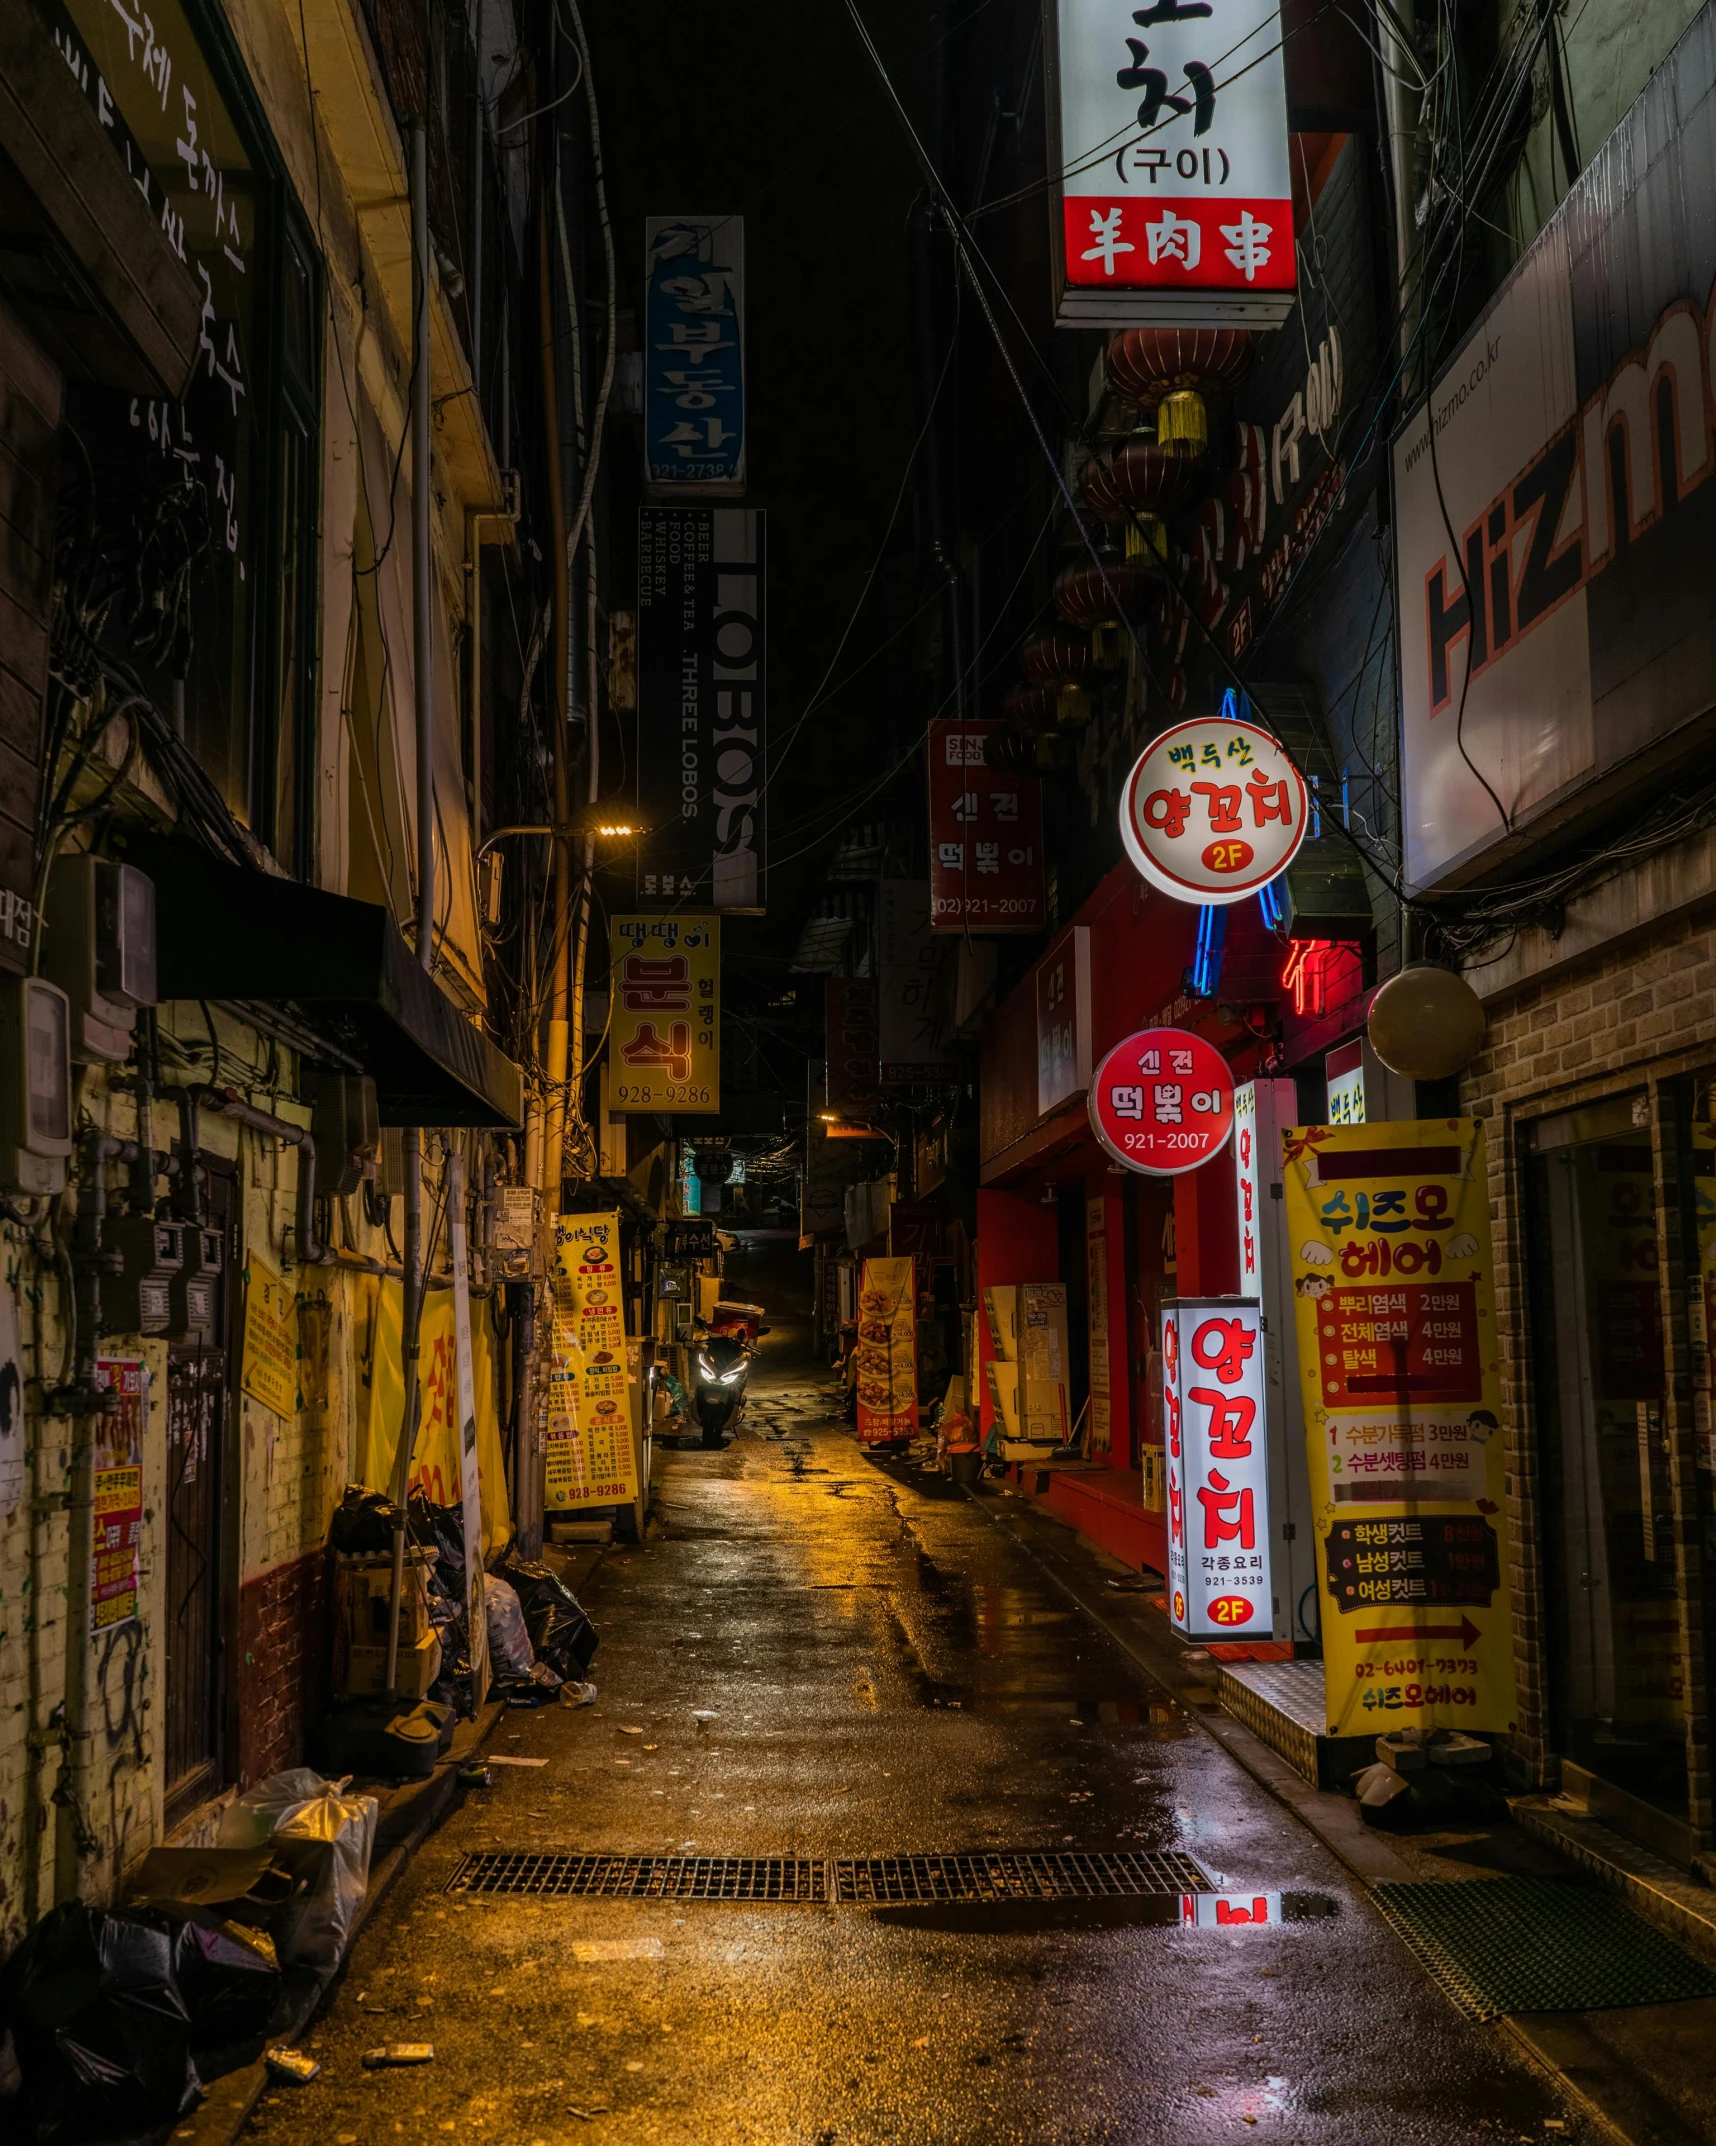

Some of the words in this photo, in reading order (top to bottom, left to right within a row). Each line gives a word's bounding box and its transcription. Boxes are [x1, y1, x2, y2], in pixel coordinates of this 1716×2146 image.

[1116, 148, 1230, 184] (구이)
[1081, 207, 1273, 282] 羊肉串
[1425, 285, 1716, 718] Hizm
[670, 521, 681, 565] FOOD
[699, 522, 710, 563] BEER
[640, 521, 652, 608] BARBECUE
[655, 521, 667, 597] WHISKEY
[1168, 736, 1256, 775] 백두산
[951, 792, 1019, 822] 신전
[1143, 768, 1293, 839] 양꼬치
[939, 842, 1033, 874] 떡볶이
[1212, 844, 1243, 869] 2F
[618, 954, 692, 1083] 분식
[1137, 1049, 1194, 1075] 신전
[618, 1085, 710, 1104] 928-9286
[1111, 1084, 1222, 1124] 떡볶이
[1236, 1087, 1255, 1119] 백두산
[1124, 1133, 1209, 1149] 921-2007
[1240, 1128, 1255, 1275] 양꼬치
[1320, 1185, 1454, 1235] 쉬즈모
[1338, 1237, 1442, 1278] 헤어
[1338, 1294, 1407, 1315] 뿌리염색
[1420, 1294, 1460, 1311] 2만원
[1340, 1321, 1409, 1343] 전체염색
[1421, 1321, 1462, 1339] 4만원
[1342, 1349, 1377, 1369] 탈색
[1422, 1348, 1462, 1365] 4만원
[1165, 1318, 1184, 1549] 양꼬치
[1188, 1318, 1257, 1549] 양꼬치
[1329, 1426, 1338, 1445] 1
[1345, 1423, 1425, 1445] 수분가득펌
[1428, 1424, 1468, 1442] 3만원
[1332, 1455, 1343, 1473] 2
[1347, 1451, 1426, 1473] 수분셋팅펌
[1430, 1452, 1469, 1470] 4만원
[568, 1483, 626, 1500] 928-9286
[1354, 1523, 1424, 1545] 학생컷트
[1201, 1555, 1263, 1571] 각종요리
[1355, 1551, 1425, 1573] 남성컷트
[1205, 1575, 1264, 1586] 921-3539
[1358, 1578, 1427, 1600] 여성컷트
[1175, 1596, 1183, 1617] 2F
[1217, 1601, 1244, 1621] 2F
[1355, 1658, 1478, 1678] 02-6401-7373
[1362, 1683, 1477, 1711] 쉬즈모헤어
